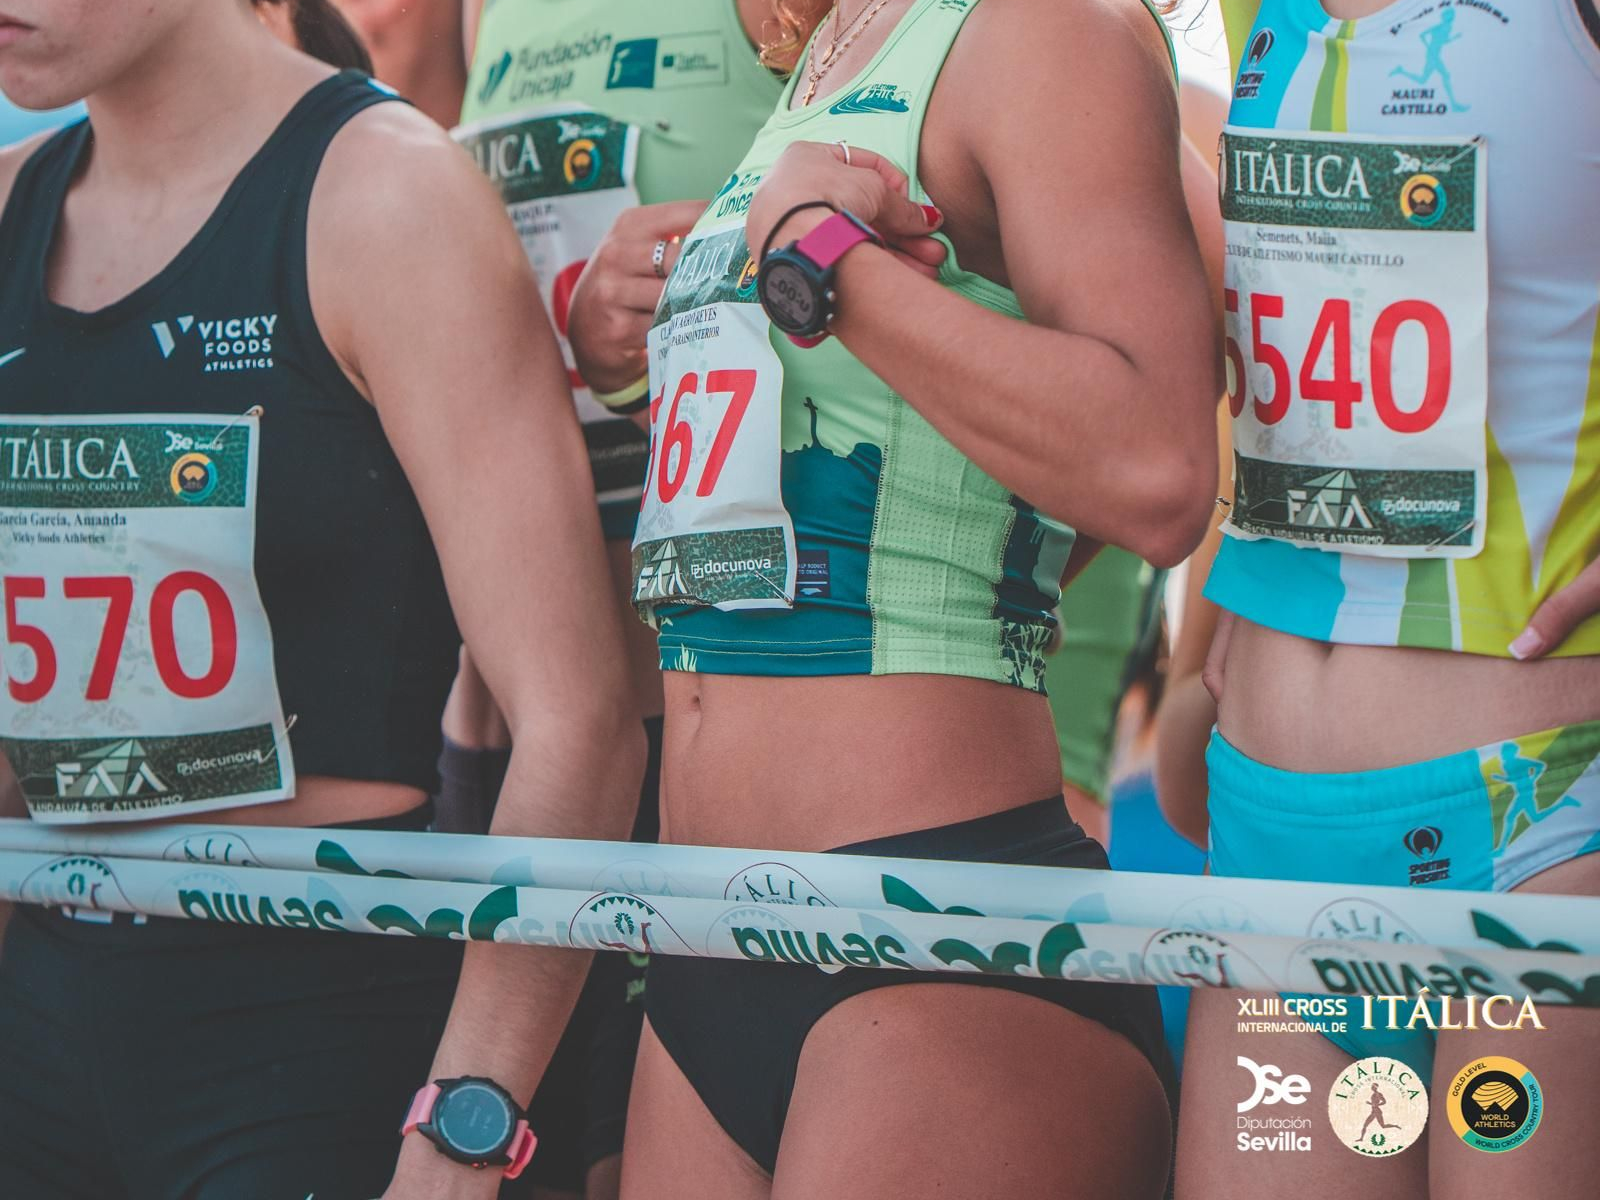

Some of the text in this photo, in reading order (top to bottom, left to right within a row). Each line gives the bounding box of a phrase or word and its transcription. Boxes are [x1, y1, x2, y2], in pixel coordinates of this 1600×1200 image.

[1391, 89, 1435, 99] MAURI
[1381, 104, 1447, 115] CASTILLO
[1234, 141, 1373, 200] ITÁLICA
[1326, 201, 1371, 212] COUNTRY
[1341, 253, 1404, 267] CASTILLO
[198, 314, 278, 340] VICKY
[205, 338, 272, 356] FOODS
[204, 358, 273, 372] ATHLETICS
[0, 428, 140, 480] TÁLICA
[88, 481, 139, 491] COUNTRY
[1395, 498, 1460, 513] docunova
[74, 512, 127, 527] Amanda
[705, 558, 772, 574] docunova
[3, 570, 238, 704] 570
[192, 748, 261, 770] docunova
[112, 794, 183, 812] ATLETISMO
